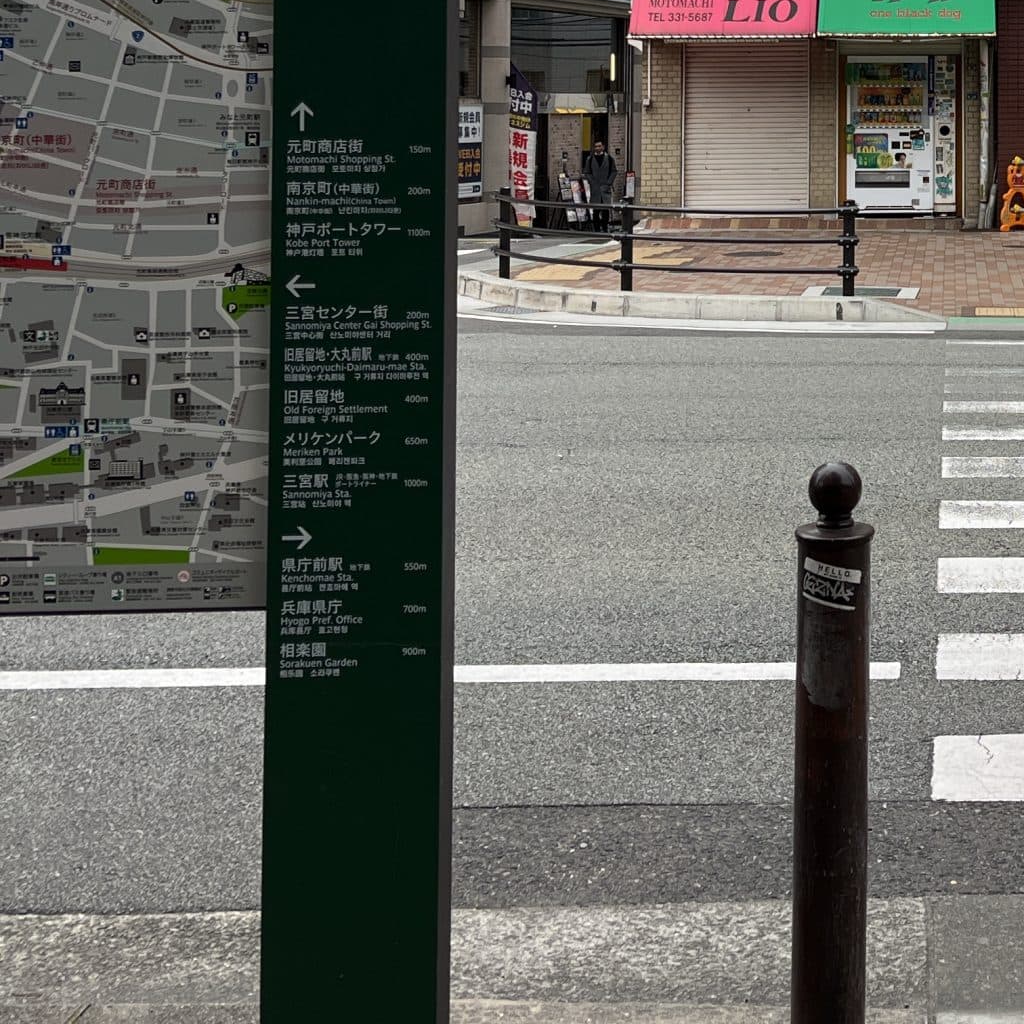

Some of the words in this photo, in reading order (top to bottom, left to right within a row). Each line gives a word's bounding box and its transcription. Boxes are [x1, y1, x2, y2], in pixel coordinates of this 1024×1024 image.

[648, 12, 667, 22] TEL
[668, 12, 713, 22] 331-5687
[937, 8, 961, 21] dog
[287, 139, 363, 154] 元町商店街
[409, 145, 431, 153] 150m
[287, 155, 338, 164] Motomachi
[340, 155, 383, 165] Shopping
[384, 155, 396, 163] St.
[286, 181, 380, 196] 南京町(中華街)
[407, 187, 431, 195] 200m
[286, 222, 401, 238] 神戸ポートタワー
[407, 228, 430, 236] 1100m
[286, 239, 309, 247] Kobe
[311, 239, 330, 247] Port
[333, 239, 360, 247] Tower
[285, 305, 389, 320] 三宮センター街
[406, 311, 430, 319] 200m
[285, 321, 332, 331] Sannomiya
[333, 321, 362, 330] Center
[364, 321, 379, 329] Gai
[380, 320, 420, 330] Shopping
[421, 320, 432, 329] St.
[405, 353, 429, 361] 400m
[410, 363, 427, 371] Sta.
[284, 389, 345, 404] 旧居留地
[405, 395, 429, 403] 400m
[283, 406, 300, 415] Old
[302, 405, 336, 416] Foreign
[338, 405, 388, 414] Settlement
[283, 430, 381, 446] メリケンパーク
[404, 437, 428, 445] 650m
[283, 448, 320, 457] Meriken
[322, 447, 343, 456] Park
[283, 474, 328, 489] 三宮駅
[404, 479, 428, 487] 1000m
[283, 490, 333, 500] Sannomiya
[334, 490, 352, 498] Sta.
[282, 557, 343, 573] 県庁前駅
[404, 563, 427, 571] 550m
[818, 564, 850, 577] HELLO
[281, 574, 335, 583] Kenchomae
[337, 573, 354, 582] Sta.
[281, 600, 343, 615] 兵庫県庁
[403, 605, 427, 613] 700m
[280, 617, 310, 627] Hyogo
[312, 616, 333, 625] Pref.
[335, 615, 363, 624] Office
[280, 642, 327, 658] 相楽園
[402, 647, 426, 656] 900m
[280, 660, 322, 669] Sorakuen
[324, 659, 358, 667] Garden
